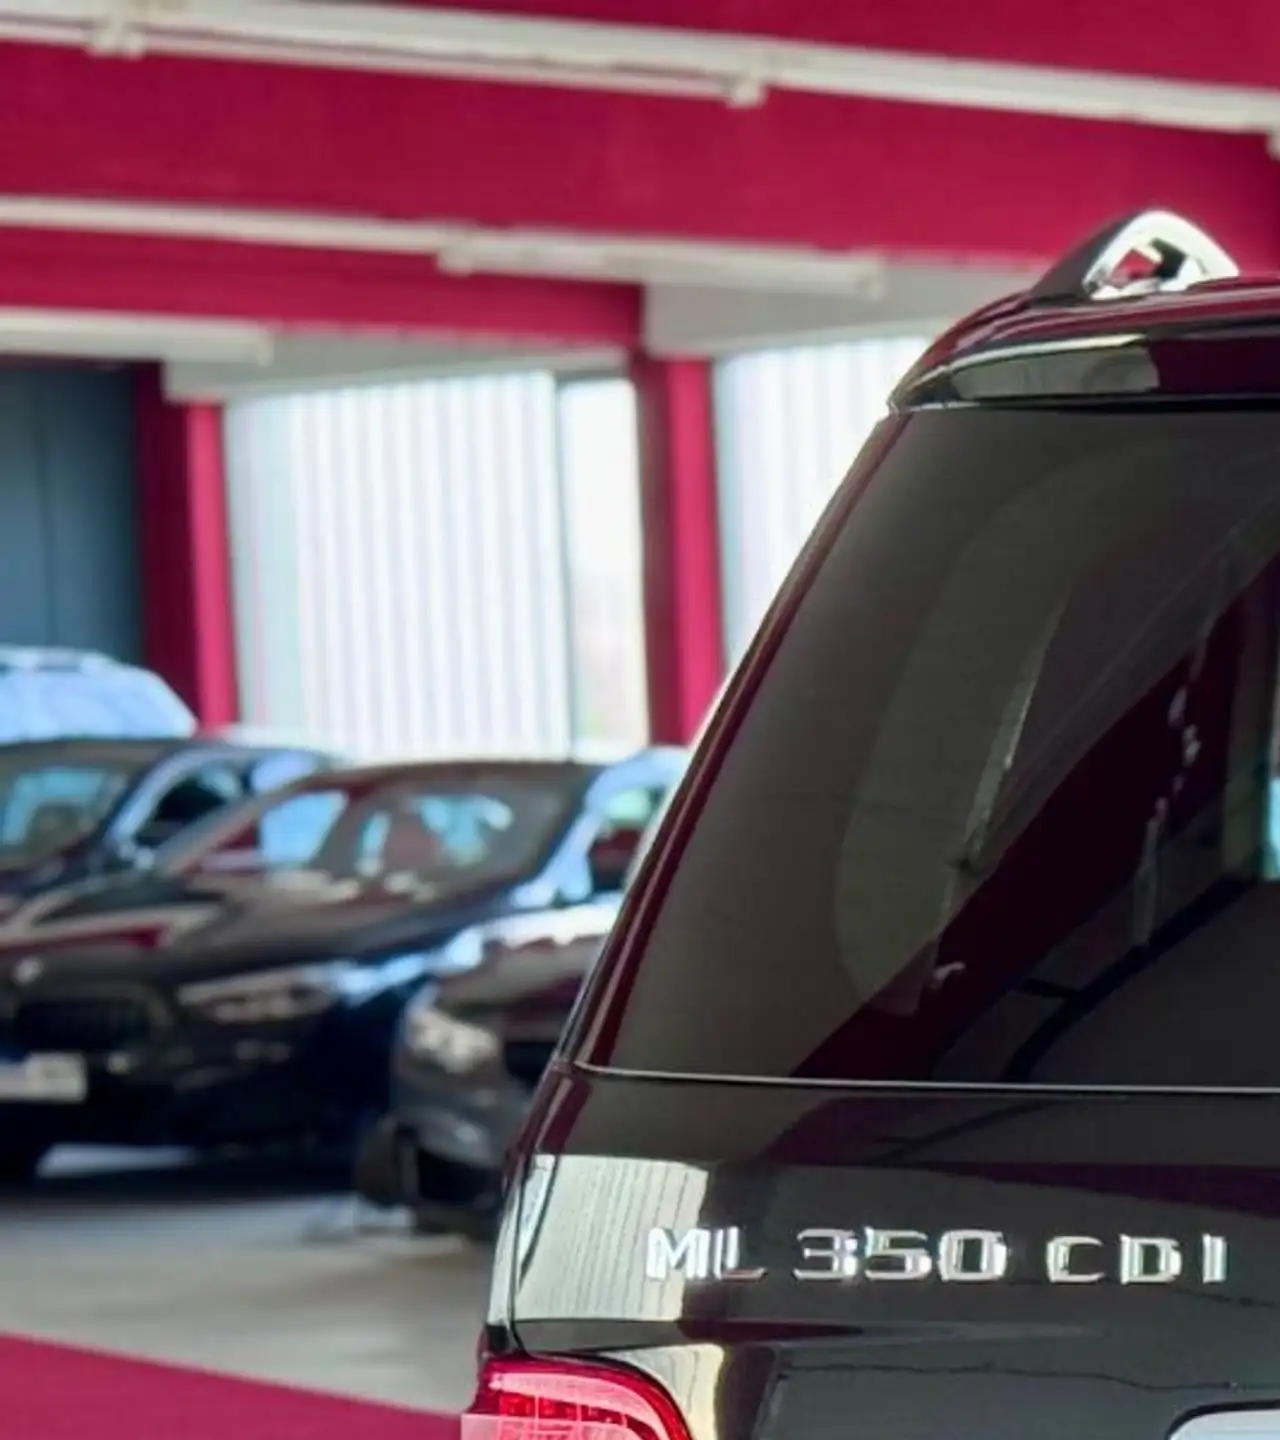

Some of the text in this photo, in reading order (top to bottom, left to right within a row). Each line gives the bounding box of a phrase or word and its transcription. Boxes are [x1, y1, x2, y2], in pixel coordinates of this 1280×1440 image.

[644, 1226, 1229, 1285] ML 350 CDI
